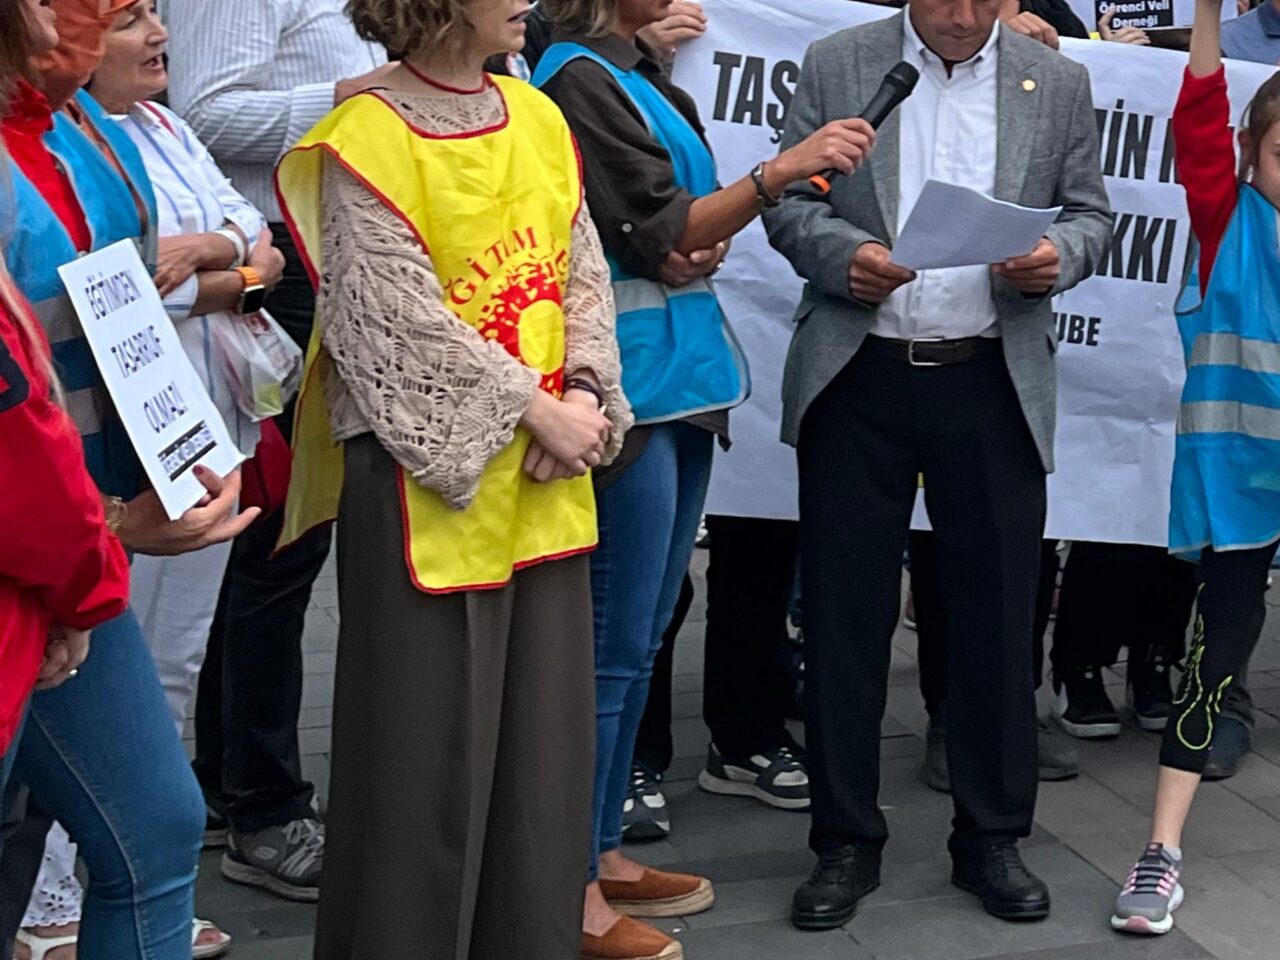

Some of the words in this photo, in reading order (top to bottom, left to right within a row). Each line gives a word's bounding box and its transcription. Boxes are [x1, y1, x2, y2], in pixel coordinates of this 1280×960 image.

[1112, 16, 1158, 29] Derneği
[712, 50, 801, 144] TAŞ
[1053, 312, 1101, 347] UBE
